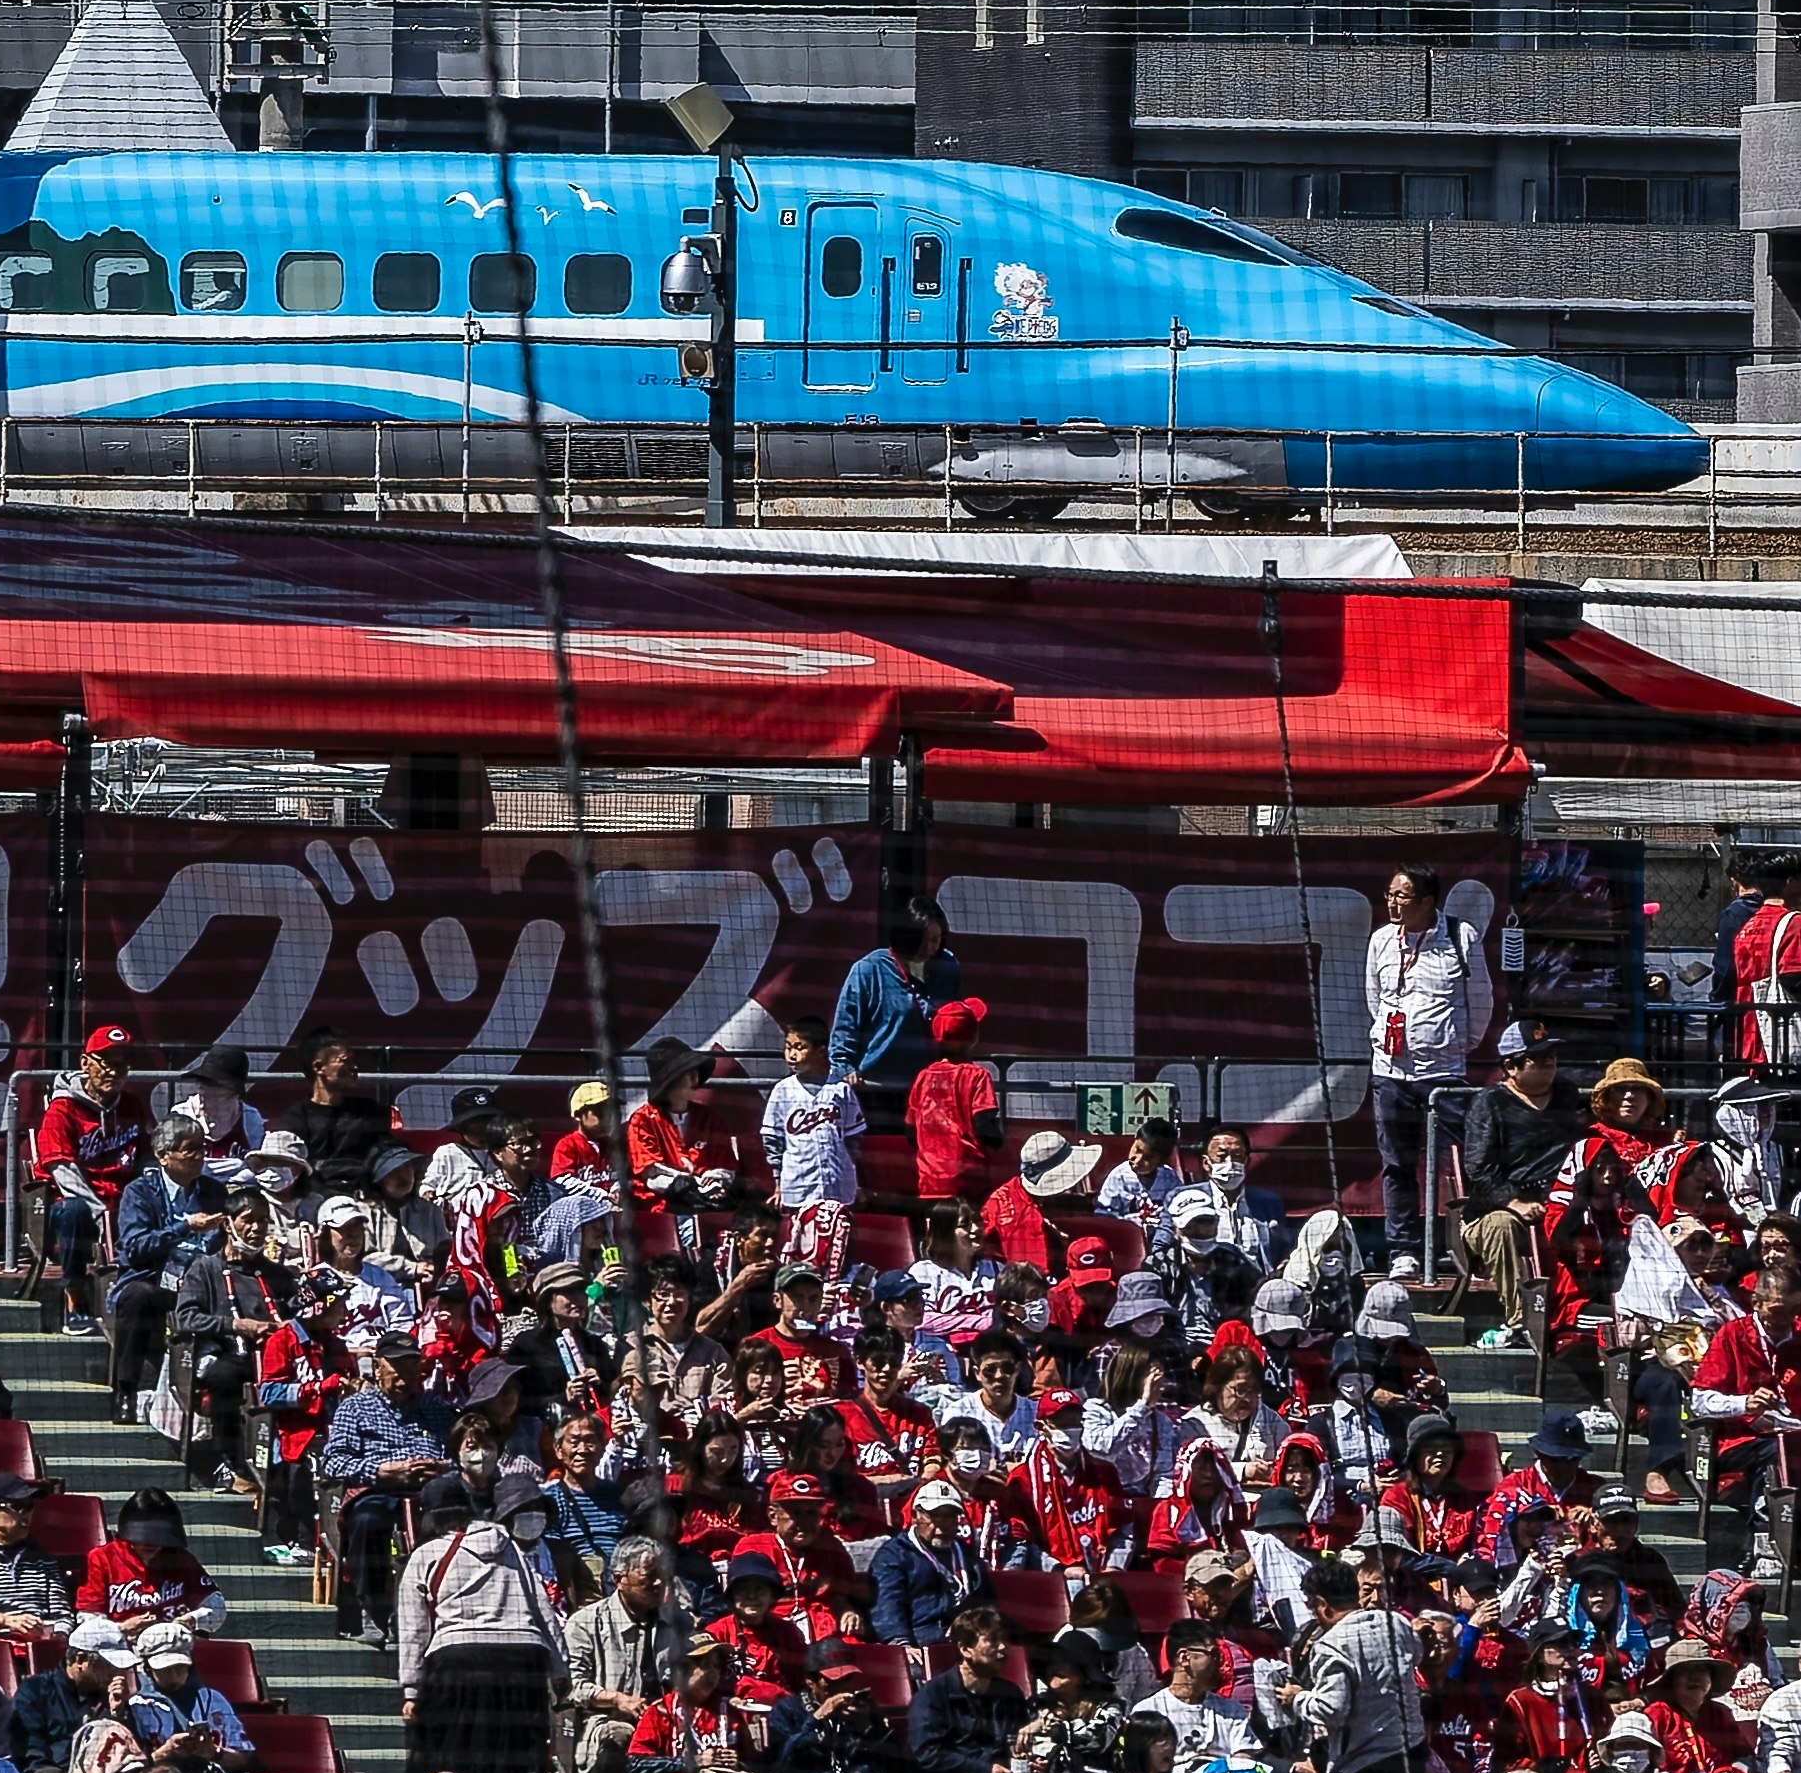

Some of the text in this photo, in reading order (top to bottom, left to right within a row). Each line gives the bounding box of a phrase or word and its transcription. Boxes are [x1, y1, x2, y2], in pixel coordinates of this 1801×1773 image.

[783, 210, 794, 224] 8
[638, 373, 657, 386] JR
[786, 1105, 842, 1136] Carp
